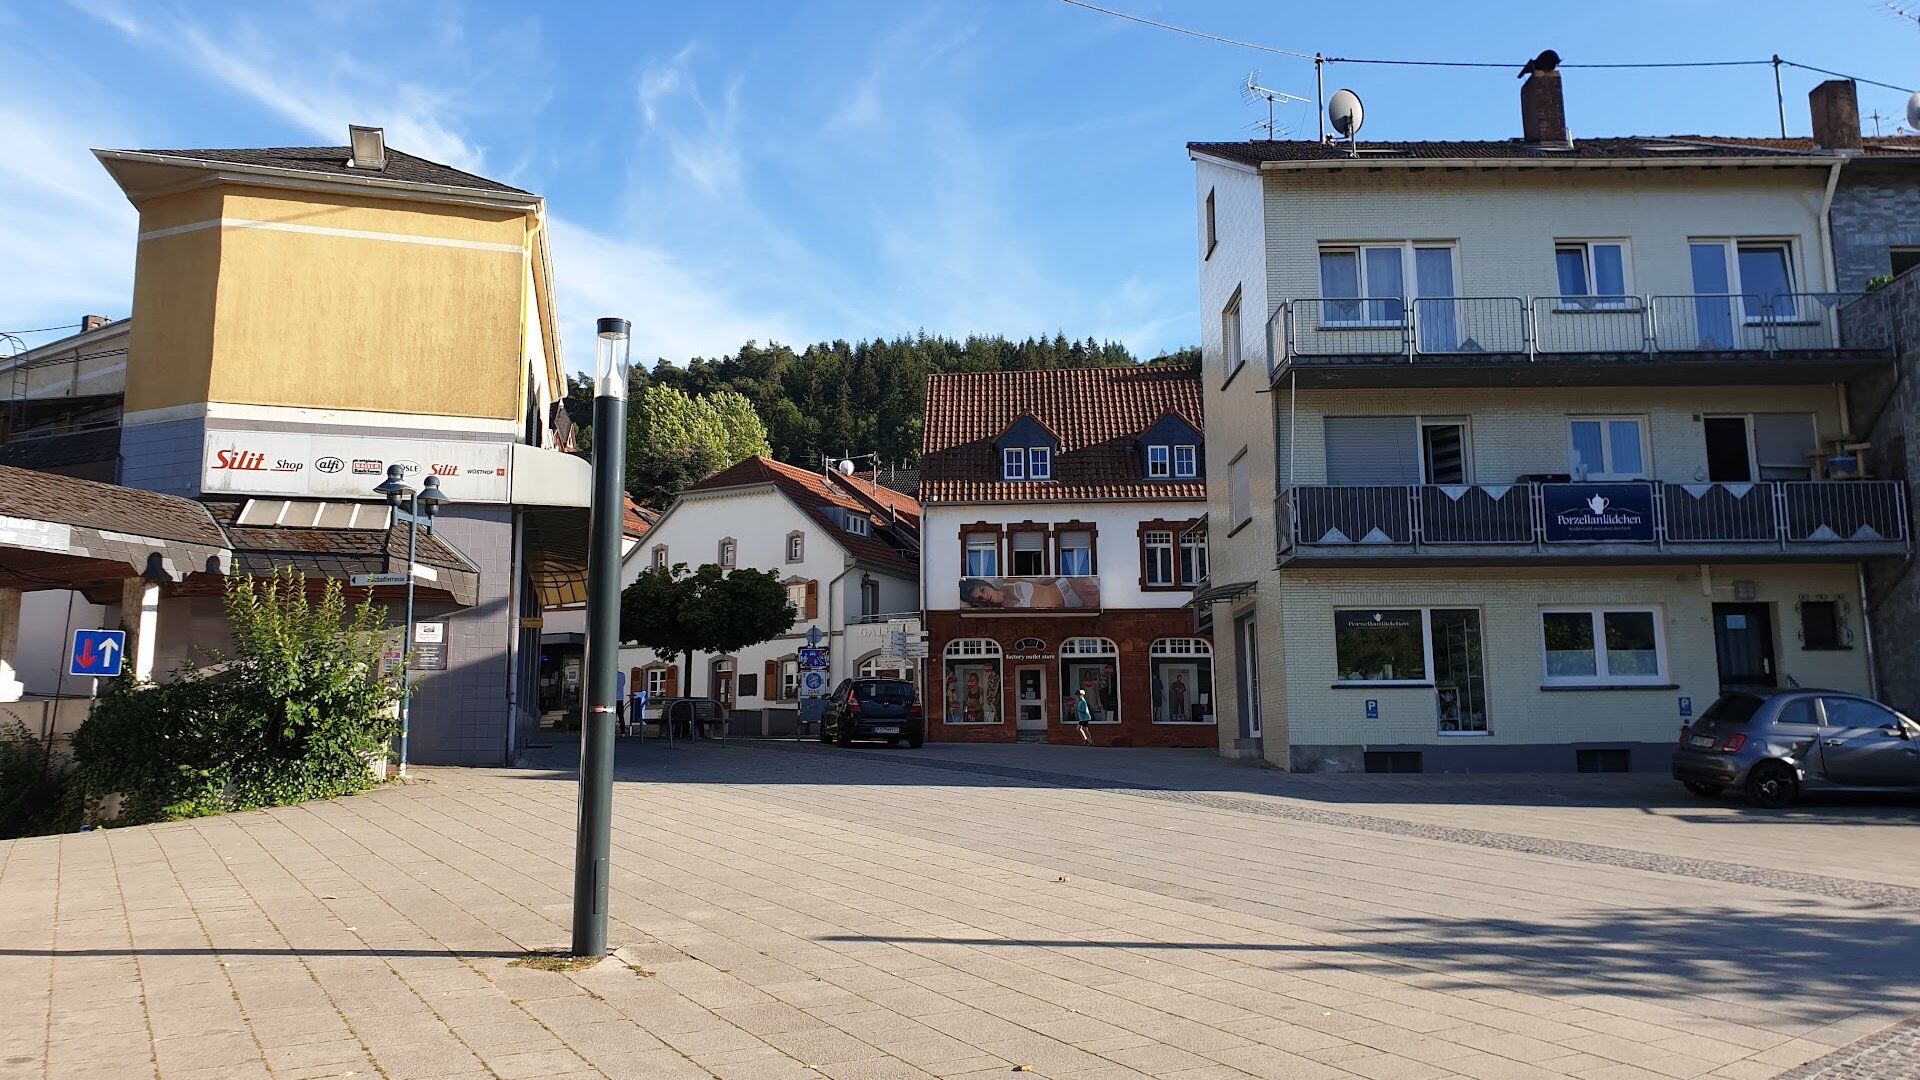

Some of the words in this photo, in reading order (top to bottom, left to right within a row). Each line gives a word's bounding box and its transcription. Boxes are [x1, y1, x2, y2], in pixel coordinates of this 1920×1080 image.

[211, 449, 268, 471] Silit
[275, 459, 304, 472] Shop
[318, 458, 341, 473] alfi
[428, 463, 460, 476] Silit
[1557, 514, 1642, 525] Porzellanlädchen
[1368, 701, 1376, 711] P
